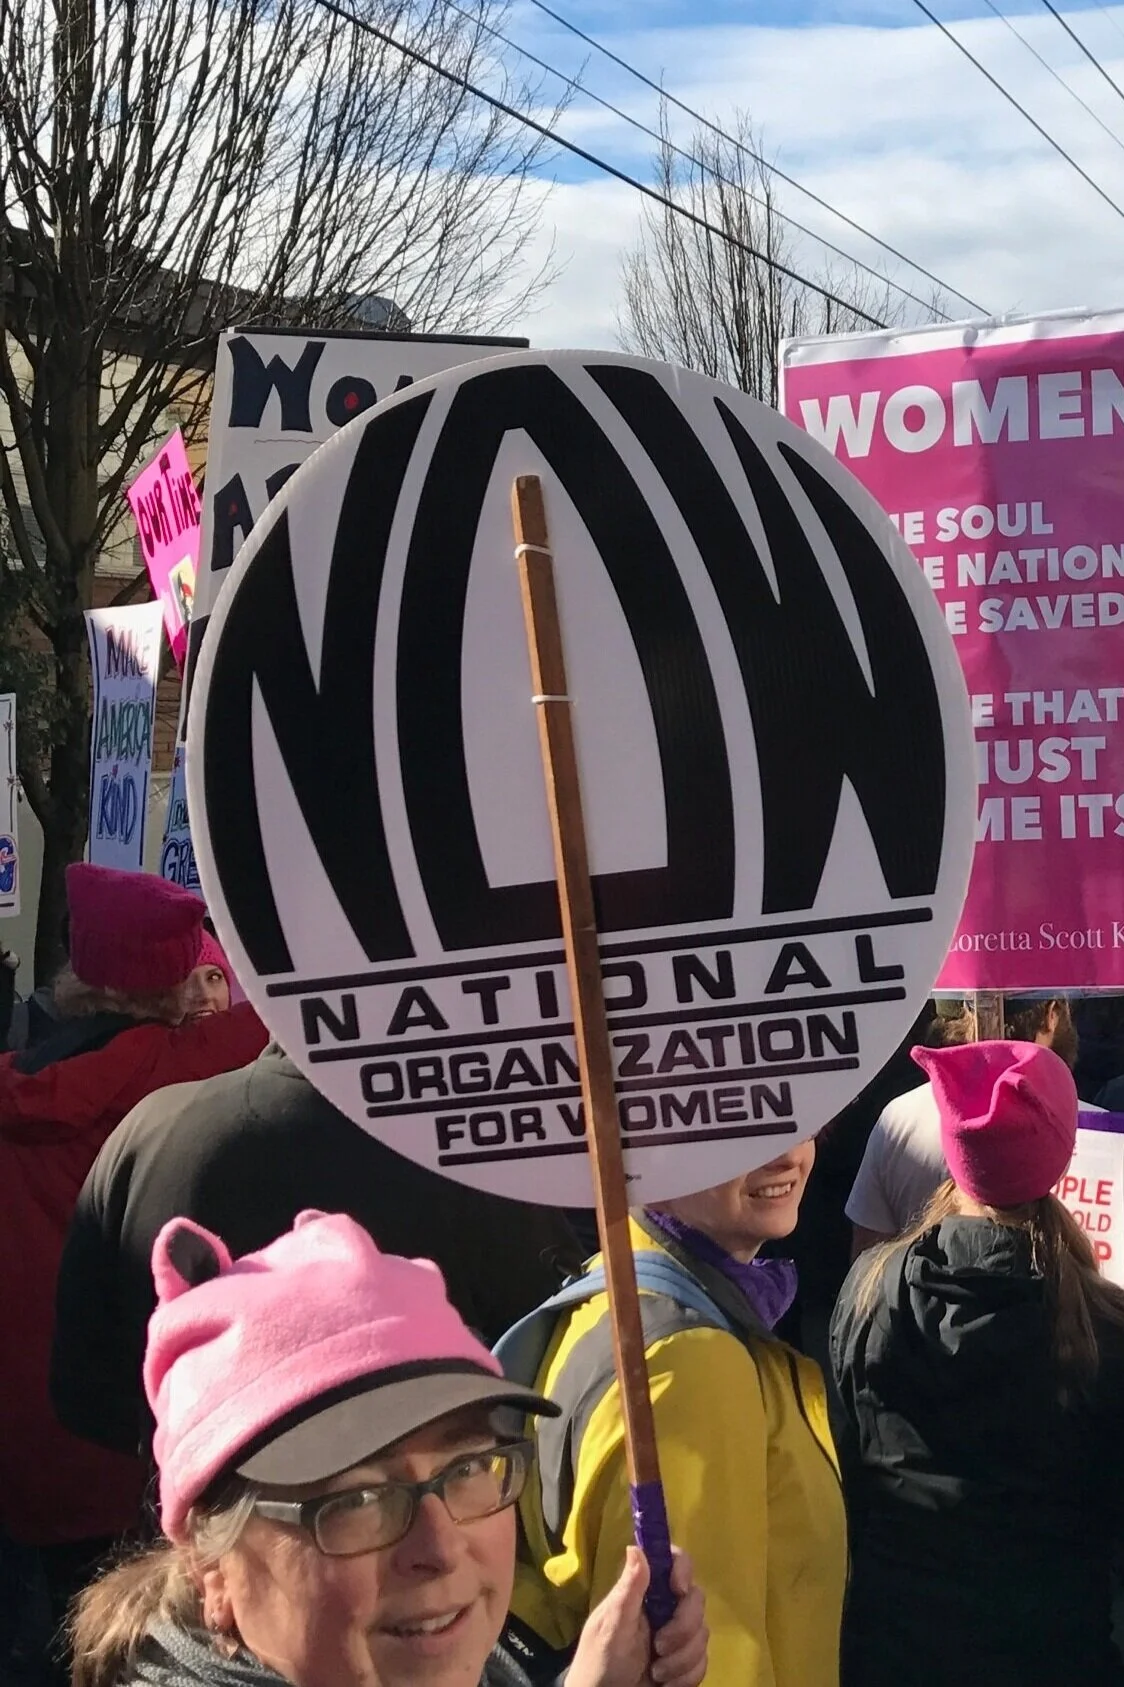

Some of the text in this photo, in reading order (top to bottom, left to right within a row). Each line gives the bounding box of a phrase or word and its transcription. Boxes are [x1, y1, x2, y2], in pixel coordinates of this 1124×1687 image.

[935, 501, 1054, 542] SOUL
[204, 364, 946, 976] NOW
[97, 773, 138, 843] KIND
[1039, 921, 1105, 950] Scott
[302, 934, 906, 1045] NATIONAL
[360, 1011, 860, 1103] ORGANZATION
[436, 1105, 548, 1151] FOR
[1055, 1176, 1114, 1206] PLE
